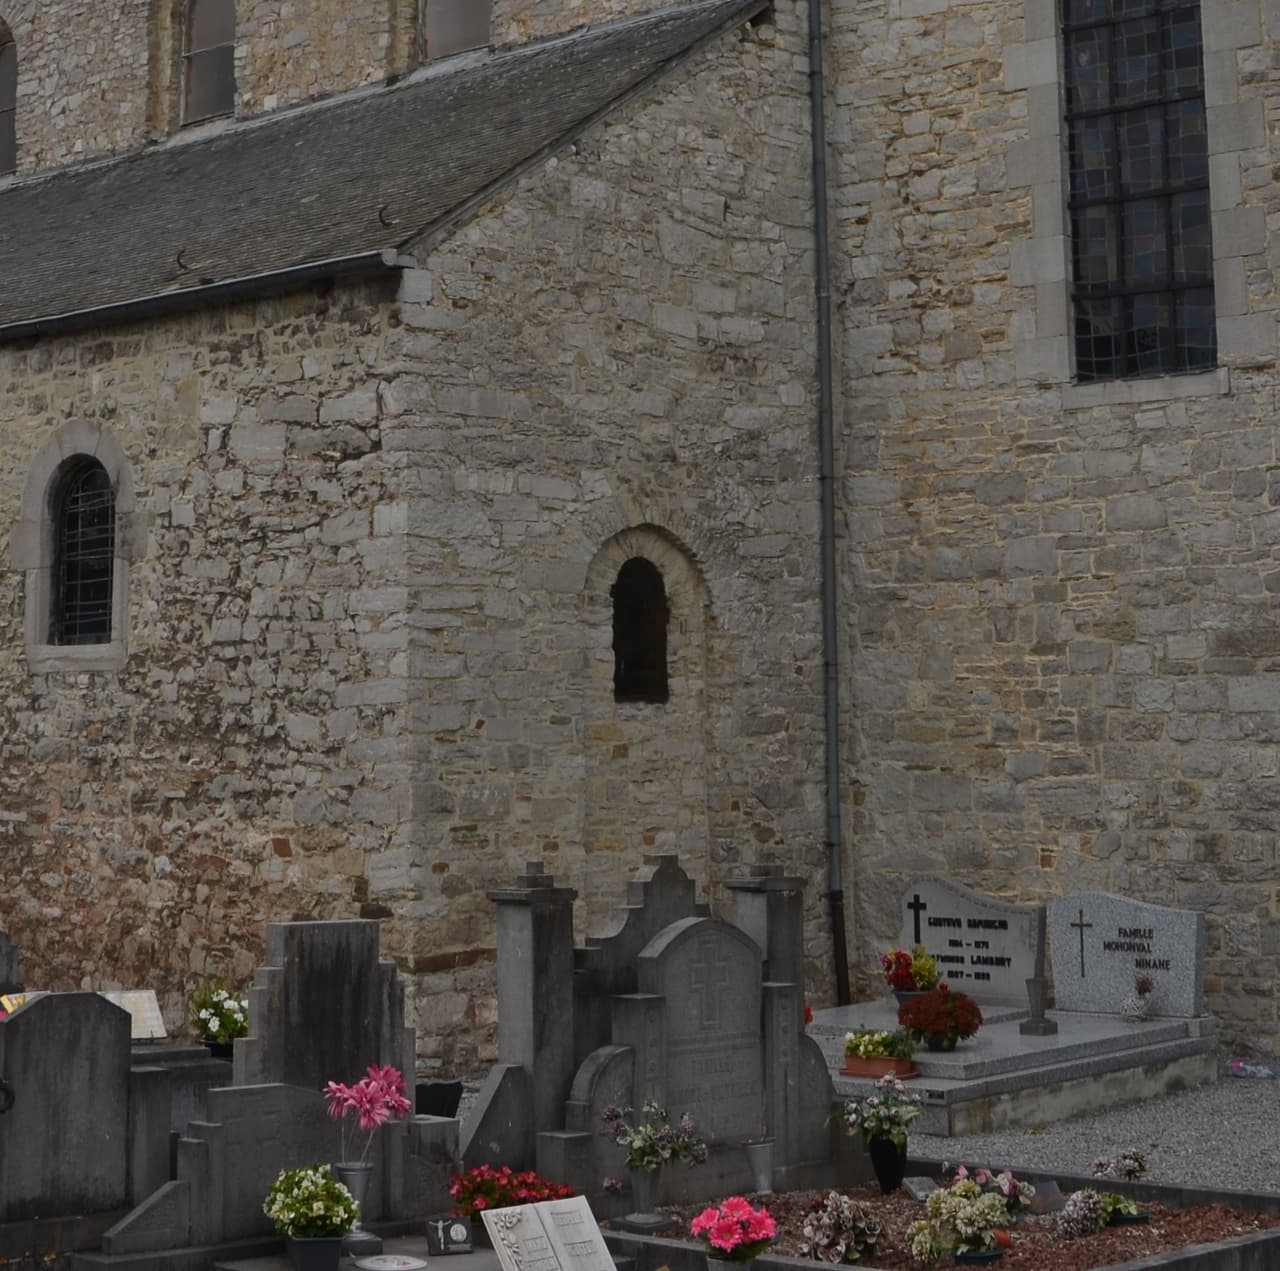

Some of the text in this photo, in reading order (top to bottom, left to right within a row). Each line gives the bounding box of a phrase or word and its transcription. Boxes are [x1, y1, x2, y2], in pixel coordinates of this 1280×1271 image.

[1118, 927, 1154, 939] FAMILLE
[970, 954, 1012, 968] LAMBERT
[1134, 957, 1171, 971] NINANE
